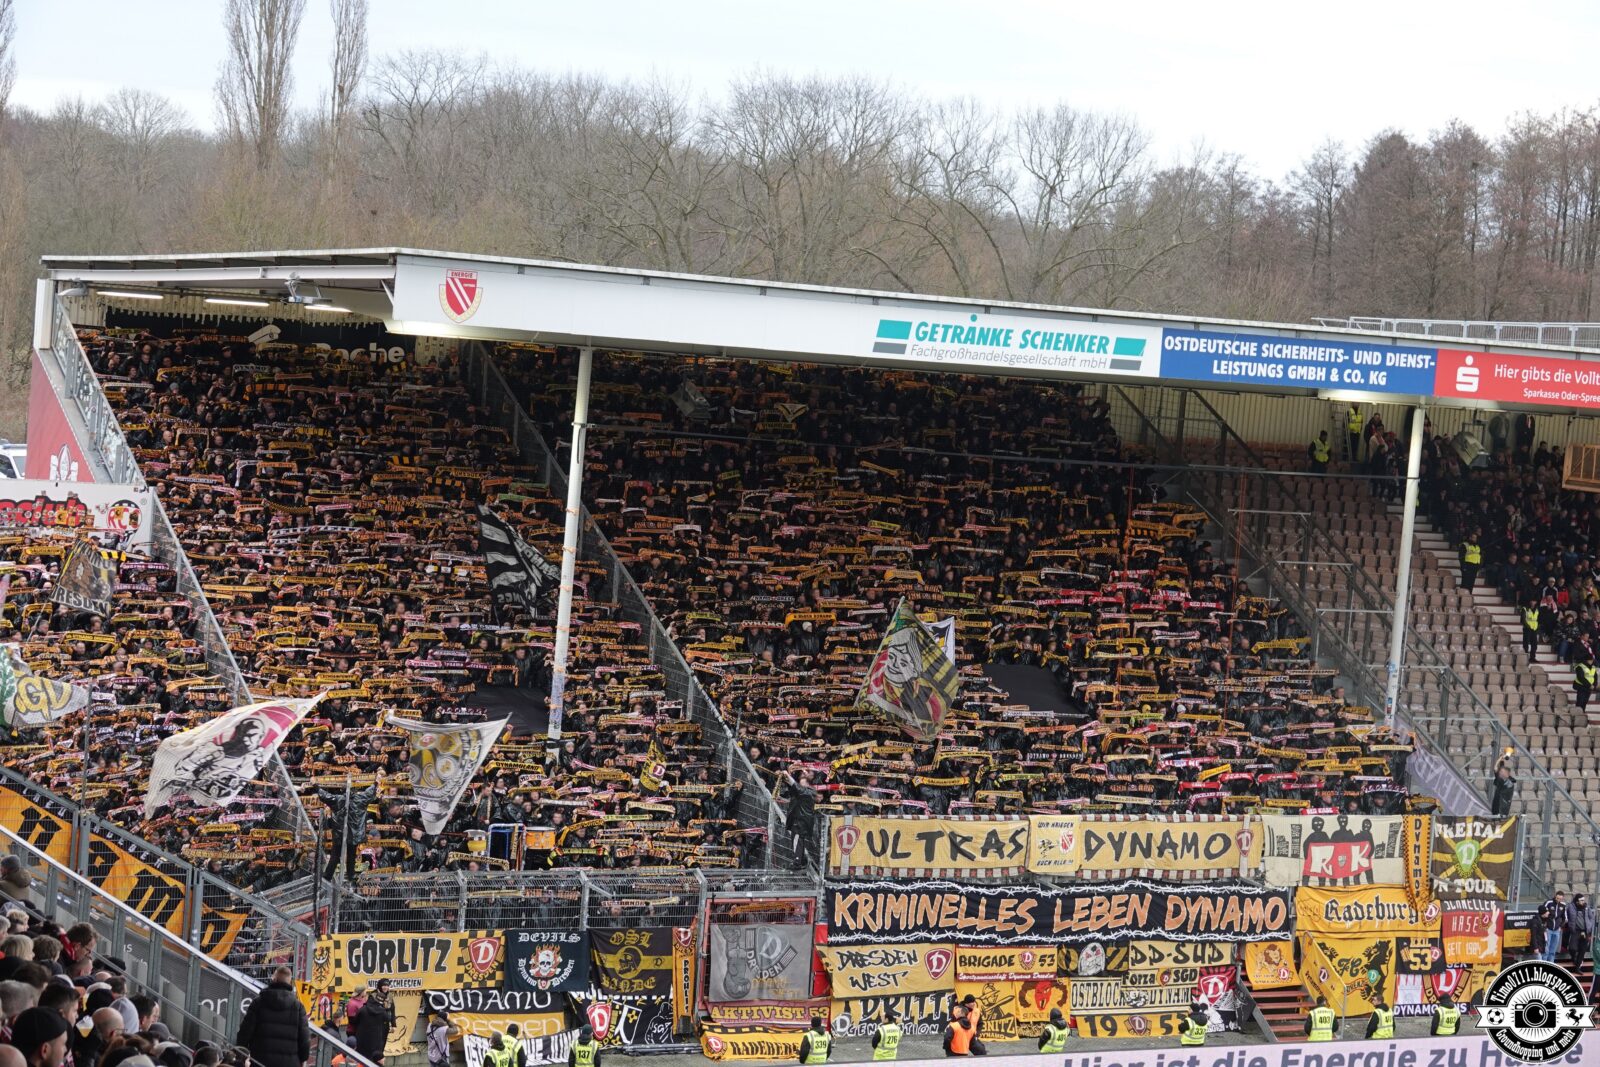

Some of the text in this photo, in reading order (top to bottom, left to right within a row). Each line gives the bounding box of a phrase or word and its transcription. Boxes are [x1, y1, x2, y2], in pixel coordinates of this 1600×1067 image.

[1019, 329, 1110, 354] SCHENKER
[1164, 335, 1436, 369] OSTDEUTSCHE SICHERHEITS- UND DIENST-
[911, 344, 1107, 369] Fachgroßhandelsgesellschaft mbH
[1212, 360, 1388, 385] LEISTUNGS GMBH & CO. KG
[1494, 364, 1520, 379] Hier
[1521, 367, 1551, 382] gibts
[1553, 369, 1572, 384] die
[1523, 387, 1560, 399] Sparkasse
[866, 828, 1027, 863] ULTRAS
[1083, 828, 1232, 863] DYNAMO
[834, 892, 1288, 934] KRIMINELLES LEBEN DYNAMO
[1451, 916, 1479, 934] HASE
[518, 932, 581, 943] DEVILS
[347, 933, 453, 975] GÖRLITZ
[836, 948, 919, 971] DRESDEN
[959, 954, 1016, 967] BRIGADE
[1038, 953, 1056, 967] 53
[1409, 948, 1432, 971] 53
[551, 959, 576, 988] Dresden
[1123, 968, 1197, 986] Forza SGD
[711, 1005, 830, 1020] AKTIVIST 53
[1084, 1015, 1118, 1037] 19
[814, 1040, 827, 1049] 339
[886, 1036, 898, 1045] 276
[577, 1050, 591, 1059] 137
